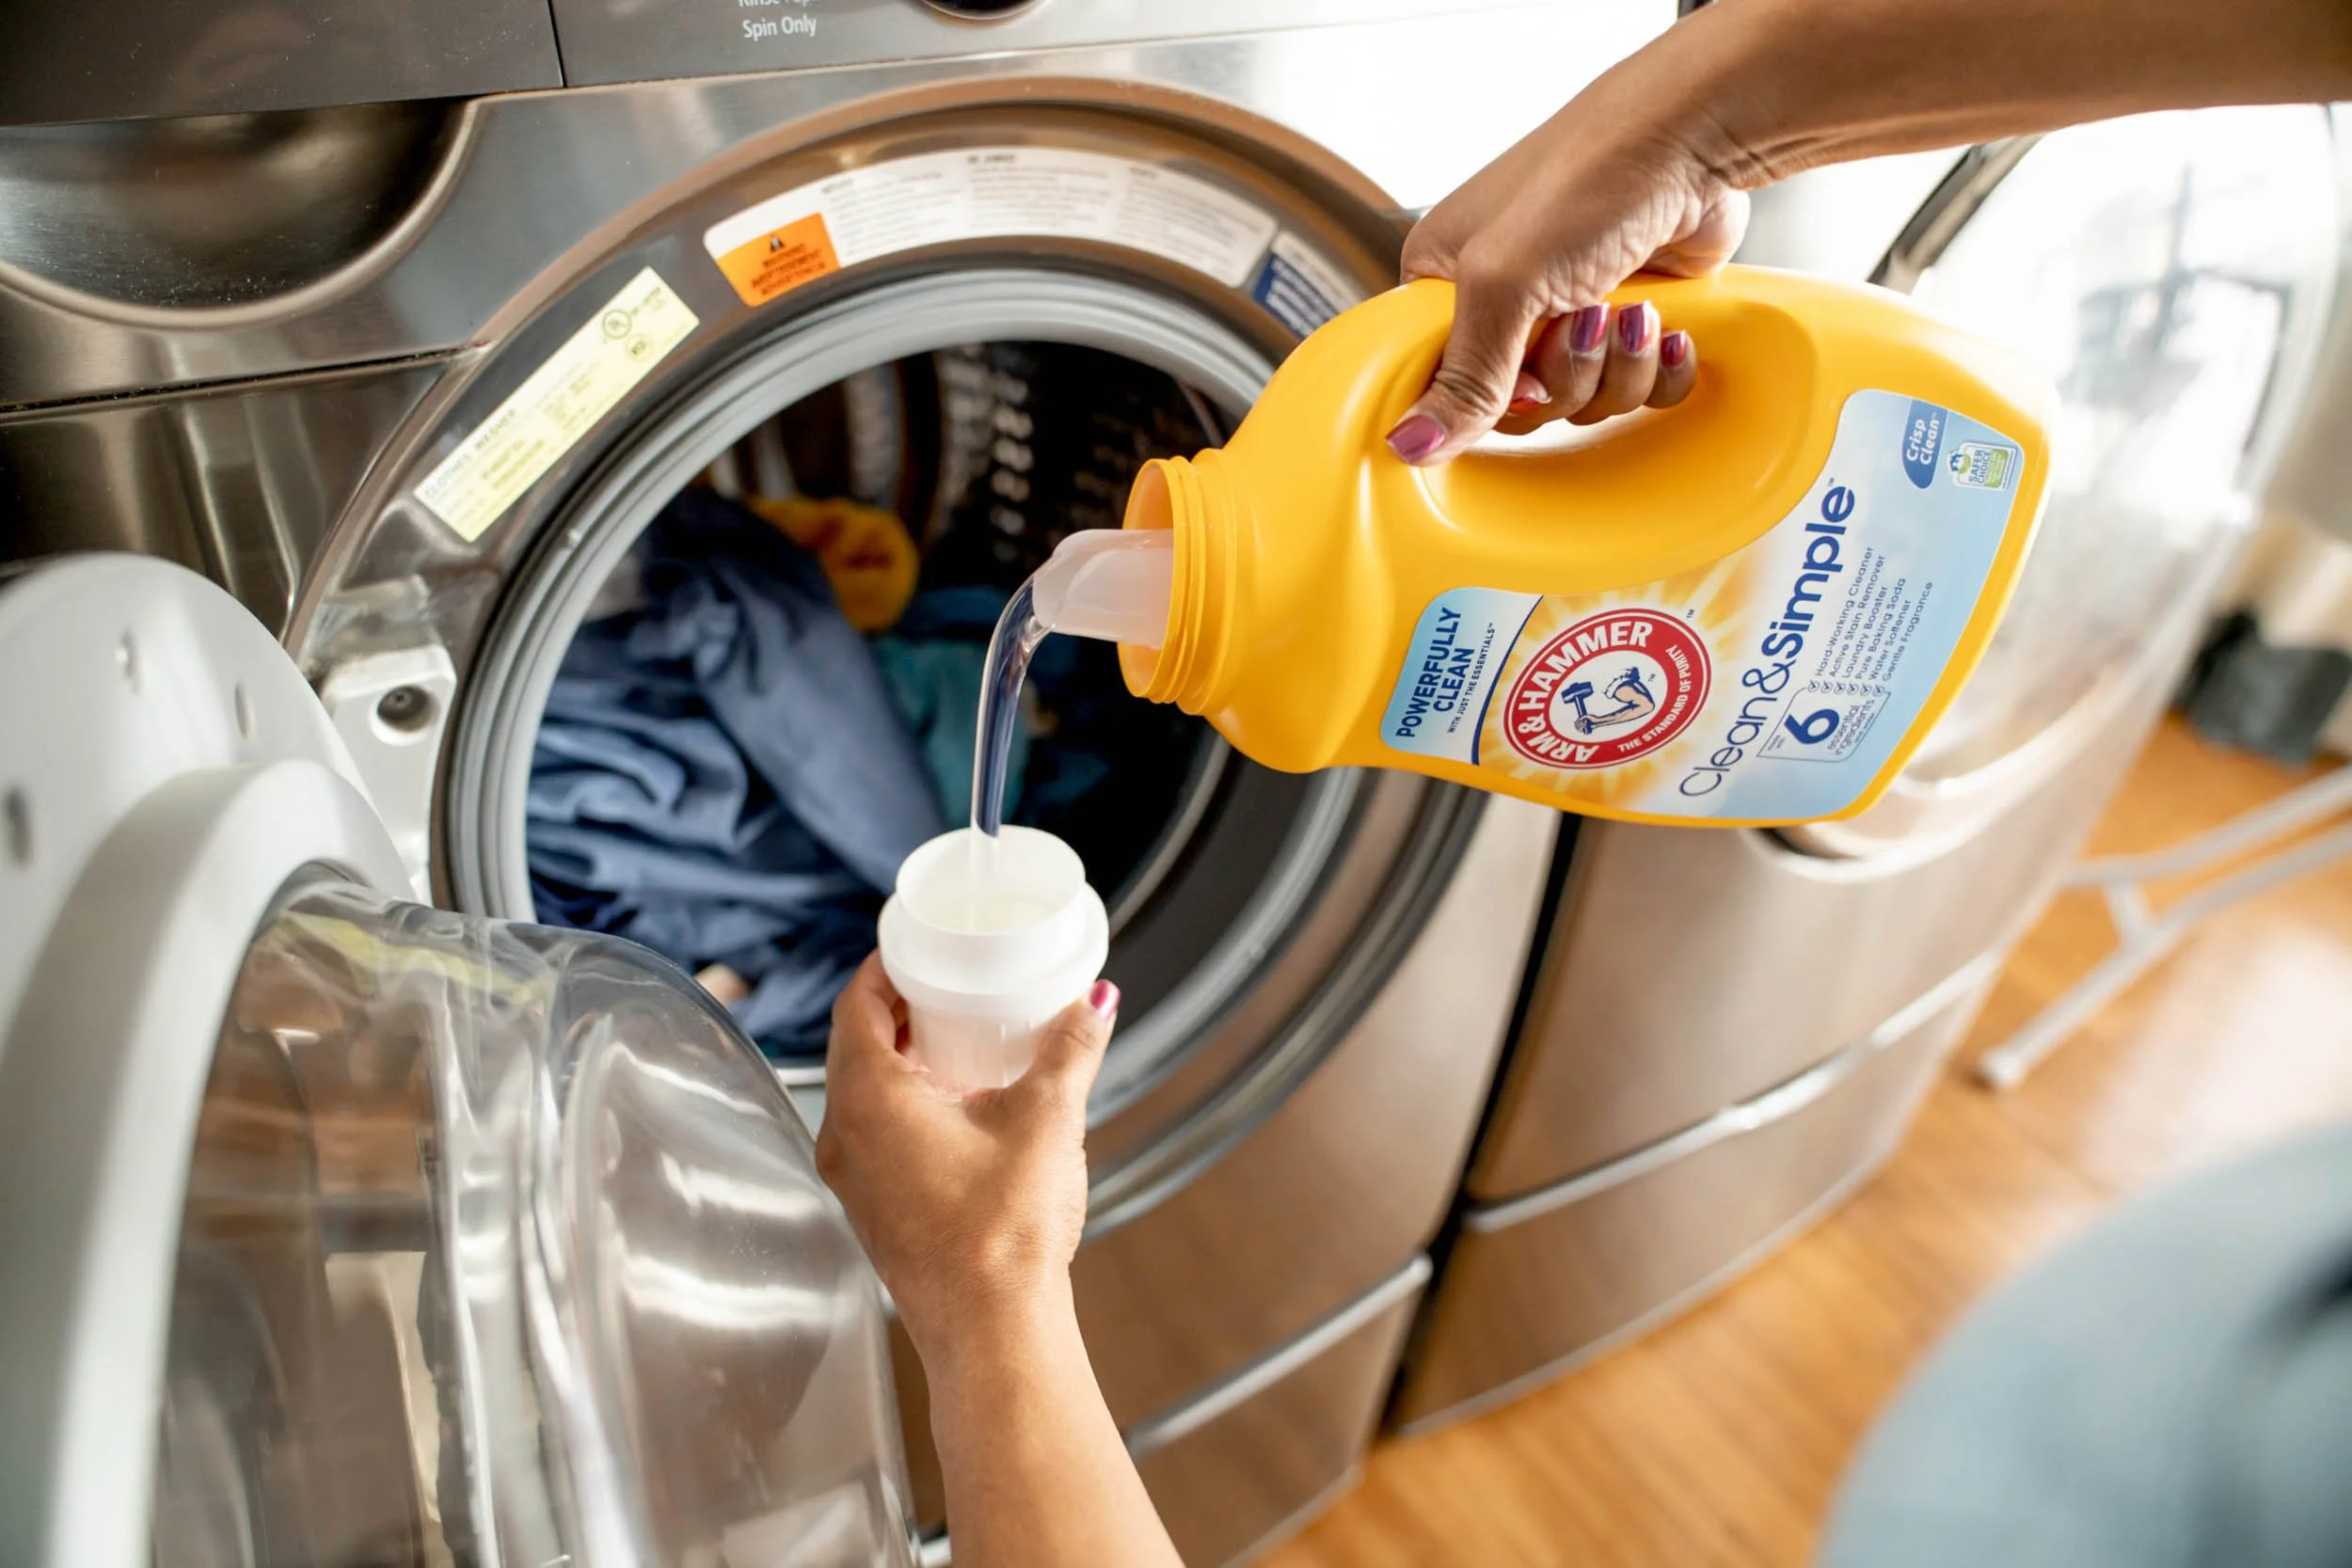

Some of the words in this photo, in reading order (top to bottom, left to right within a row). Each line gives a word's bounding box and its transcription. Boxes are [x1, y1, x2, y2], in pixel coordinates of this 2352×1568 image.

[742, 18, 778, 42] Spin
[781, 13, 818, 38] Only
[1906, 419, 1927, 462] Crisp
[1968, 450, 1984, 483] SAFER
[1976, 451, 1993, 484] CHOICE
[1815, 599, 1856, 676] Hard-Working
[1849, 546, 1874, 596] Cleaner
[1829, 643, 1850, 677] Active
[1845, 611, 1864, 641] Stain
[1857, 554, 1885, 610] Remover
[1842, 633, 1869, 678] Laundry
[1864, 586, 1888, 629] Booster
[1854, 656, 1872, 679] Pure
[1867, 611, 1894, 653] Baking
[1886, 578, 1906, 610] Soda
[1883, 644, 1905, 682] Gentle
[1900, 581, 1933, 642] Fragrance
[1664, 644, 1692, 679] PURITY
[1867, 649, 1890, 681] Water
[1884, 599, 1912, 647] Softener
[1395, 607, 1461, 737] POWERFULLY
[1433, 648, 1475, 712] CLEAN
[1518, 620, 1654, 711] HAMMER
[1678, 678, 1692, 693] OF
[1448, 715, 1461, 733] WITH
[1457, 697, 1470, 715] JUST
[1465, 681, 1477, 697] THE
[1643, 694, 1689, 742] STANDARD
[1784, 708, 1839, 745] 6
[1526, 730, 1599, 763] ARM
[1617, 737, 1644, 753] THE
